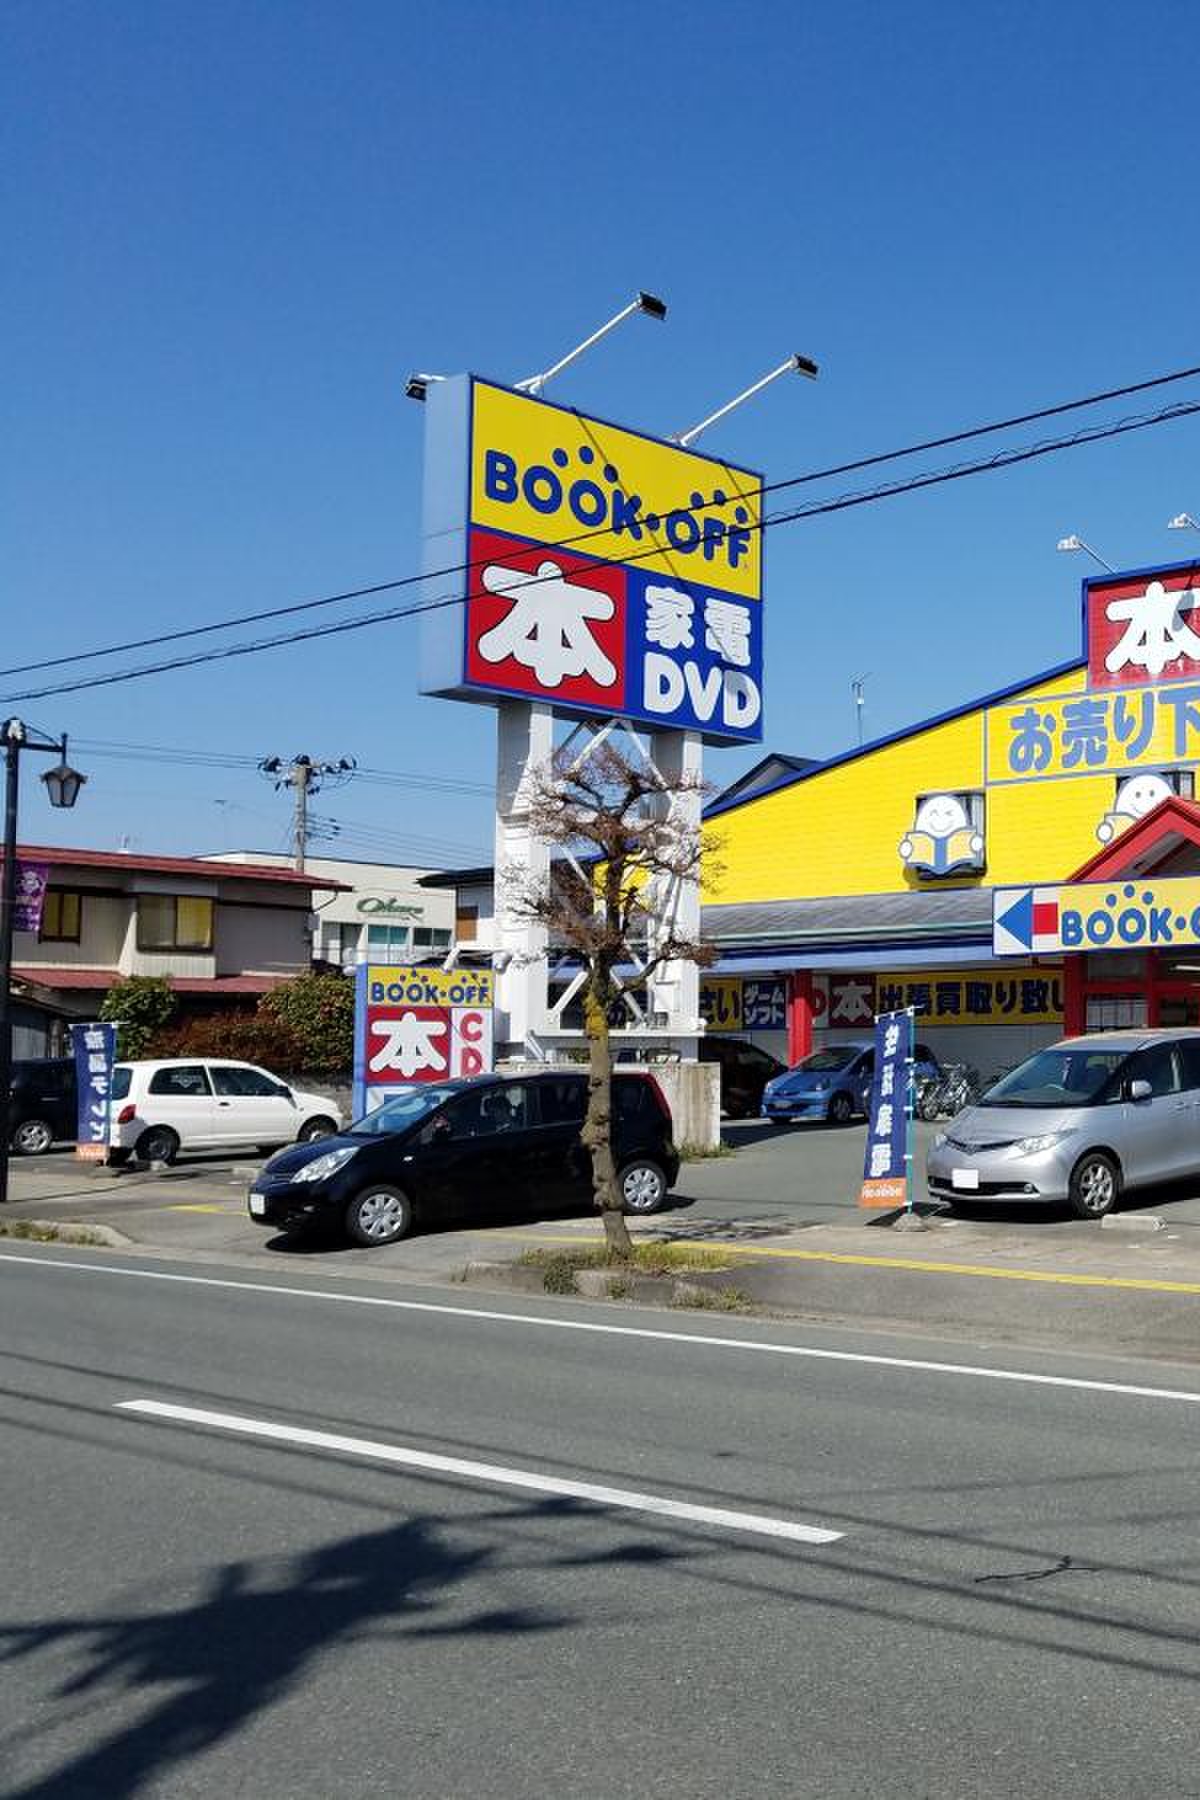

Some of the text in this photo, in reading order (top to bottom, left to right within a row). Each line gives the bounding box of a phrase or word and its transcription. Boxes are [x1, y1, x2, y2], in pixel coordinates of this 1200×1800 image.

[477, 560, 617, 688] 本
[643, 651, 761, 728] DVD
[369, 1011, 447, 1077] 本
